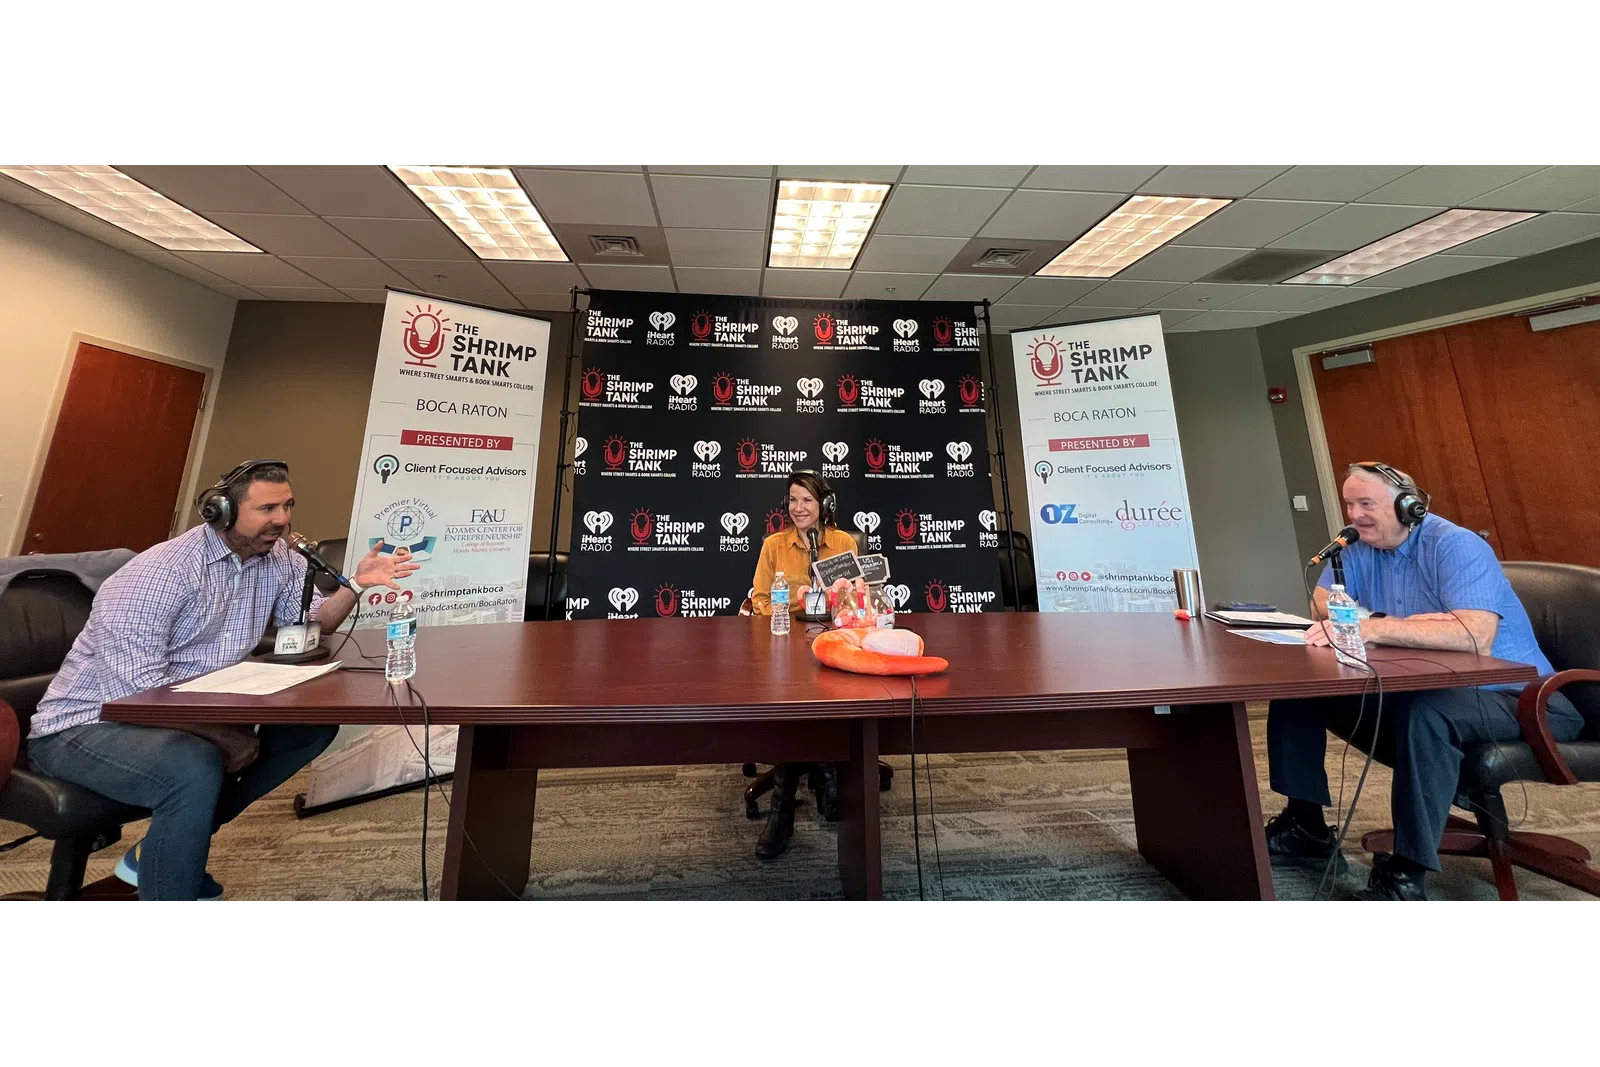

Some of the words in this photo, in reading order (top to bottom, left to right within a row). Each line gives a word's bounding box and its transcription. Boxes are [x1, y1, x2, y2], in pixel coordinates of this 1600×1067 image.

[587, 316, 634, 328] SHRIMP
[714, 322, 760, 333] SHRIMP
[454, 322, 479, 336] THE
[586, 326, 618, 338] TANK
[836, 326, 880, 336] SHRIMP
[954, 328, 978, 336] SHRI
[646, 331, 675, 339] iHeart
[714, 332, 746, 342] TANK
[836, 335, 867, 345] TANK
[452, 335, 537, 362] SHRIMP
[1068, 340, 1090, 350] THE
[1070, 344, 1152, 367] SHRIMP
[450, 354, 511, 378] TANK
[400, 368, 422, 378] WHERE
[423, 372, 444, 380] STREET
[445, 374, 469, 384] SMARTS
[474, 378, 491, 386] BOOK
[491, 380, 513, 388] SMARTS
[513, 382, 534, 391] COLLIDE
[1070, 364, 1130, 384] TANK
[606, 381, 654, 392] SHRIMP
[736, 385, 782, 396] SHRIMP
[860, 386, 905, 398] SHRIMP
[606, 392, 638, 403] TANK
[668, 396, 698, 404] iHeart
[736, 396, 768, 406] TANK
[860, 396, 892, 408] TANK
[416, 398, 458, 414] BOCA
[461, 403, 508, 418] RATON
[668, 403, 698, 412] RADIO
[1054, 410, 1090, 422] BOCA
[1092, 407, 1136, 420] RATON
[416, 434, 484, 448] PRESENTED
[487, 439, 501, 448] BY
[1061, 438, 1120, 450] PRESENTED
[1123, 437, 1136, 446] BY
[629, 449, 678, 460] SHRIMP
[761, 450, 808, 462] SHRIMP
[888, 452, 934, 462] SHRIMP
[404, 463, 436, 473] Client
[438, 465, 484, 475] Focused
[485, 466, 527, 476] Advisors
[628, 460, 662, 471] TANK
[692, 462, 721, 470] iHeart
[761, 462, 794, 472] TANK
[888, 462, 920, 473] TANK
[947, 462, 974, 470] iHeart
[1057, 465, 1084, 474] Client
[1086, 464, 1126, 473] Focused
[1128, 462, 1172, 472] Advisors
[692, 470, 721, 478] RADIO
[822, 470, 850, 478] RADIO
[374, 498, 410, 521] Premier
[413, 498, 438, 520] Virtual
[1115, 500, 1182, 521] durée
[470, 509, 506, 523] FAU
[399, 515, 412, 533] P
[656, 522, 705, 533] SHRIMP
[920, 520, 965, 531] SHRIMP
[1137, 520, 1181, 529] company
[444, 532, 523, 541] ENTREPRENEURSHIP
[582, 535, 612, 544] iHeart
[655, 534, 690, 545] TANK
[720, 536, 749, 544] iHeart
[920, 532, 952, 543] TANK
[581, 544, 612, 552] RADIO
[720, 544, 749, 552] RADIO
[1098, 573, 1174, 582] @shrimptankboca
[420, 585, 504, 599] @shrimptankboca
[1046, 585, 1176, 595] www.ShrimpTankPodcast.com/BocaR
[950, 592, 996, 603] SHRIMP
[349, 598, 517, 619] www.ShrnkPodcast.com/BocaRaton
[566, 598, 590, 610] IMP
[681, 598, 731, 609] SHRIMP
[950, 604, 983, 613] TANK
